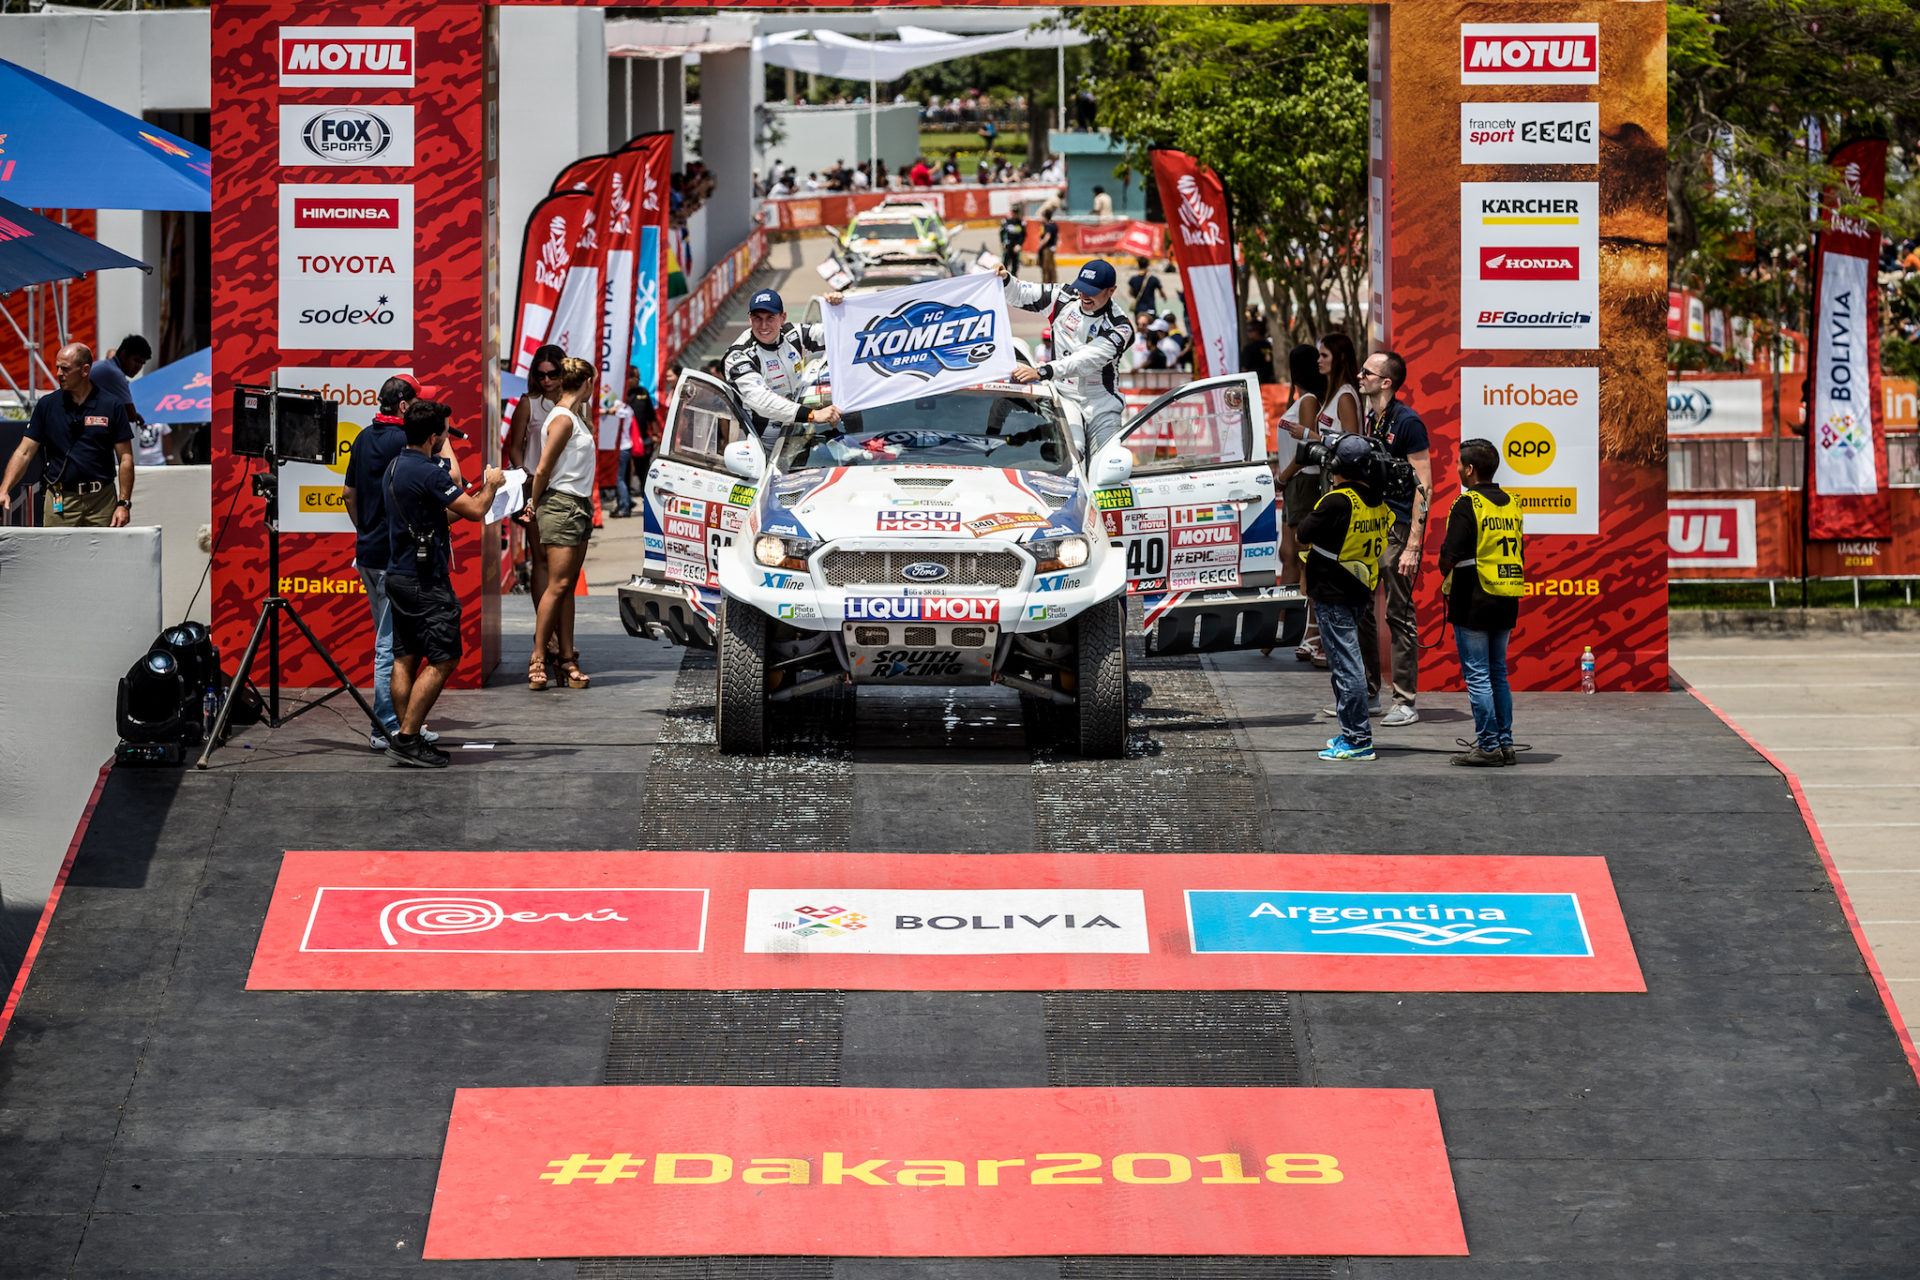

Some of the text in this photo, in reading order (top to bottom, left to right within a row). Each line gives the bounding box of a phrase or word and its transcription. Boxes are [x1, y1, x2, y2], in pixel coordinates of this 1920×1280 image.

[287, 44, 407, 71] MOTUL
[1469, 40, 1591, 67] MOTUL
[321, 120, 372, 142] FOX
[1469, 129, 1515, 145] sport
[321, 143, 373, 151] SPORTS
[302, 208, 391, 219] HIMOINSA
[1482, 199, 1579, 214] KÄRCHER
[297, 255, 396, 274] TOYOTA
[1505, 258, 1574, 269] HONDA
[299, 304, 395, 325] sodexo
[922, 310, 945, 324] HC
[1478, 311, 1591, 324] BFGoodrich
[860, 313, 993, 359] KOMETA
[1831, 291, 1851, 401] BOLIVIA
[892, 352, 929, 367] BRNO
[1483, 383, 1579, 406] infobae
[1668, 394, 1695, 412] OX
[1095, 488, 1132, 500] MANN
[1521, 494, 1572, 508] omercio
[1097, 497, 1133, 509] FILTER
[881, 512, 958, 521] LIQUI
[1139, 520, 1166, 529] MOTUL
[667, 519, 701, 539] MOTUL
[881, 521, 959, 531] MOLY
[1178, 527, 1233, 545] MOTUL
[1243, 546, 1275, 558] TECHO
[1362, 537, 1382, 558] 16
[1496, 535, 1518, 557] 17
[1111, 537, 1164, 576] 40
[1173, 550, 1214, 565] #EPIC
[911, 564, 938, 578] Ford
[1172, 577, 1196, 588] sport
[1524, 579, 1600, 597] ar2018
[847, 598, 999, 619] LIQUI MOLY
[872, 650, 962, 664] SOUTH
[1248, 900, 1507, 922] Argentina
[895, 914, 1122, 930] BOLIVIA
[538, 1151, 1346, 1188] #Dakar2018
